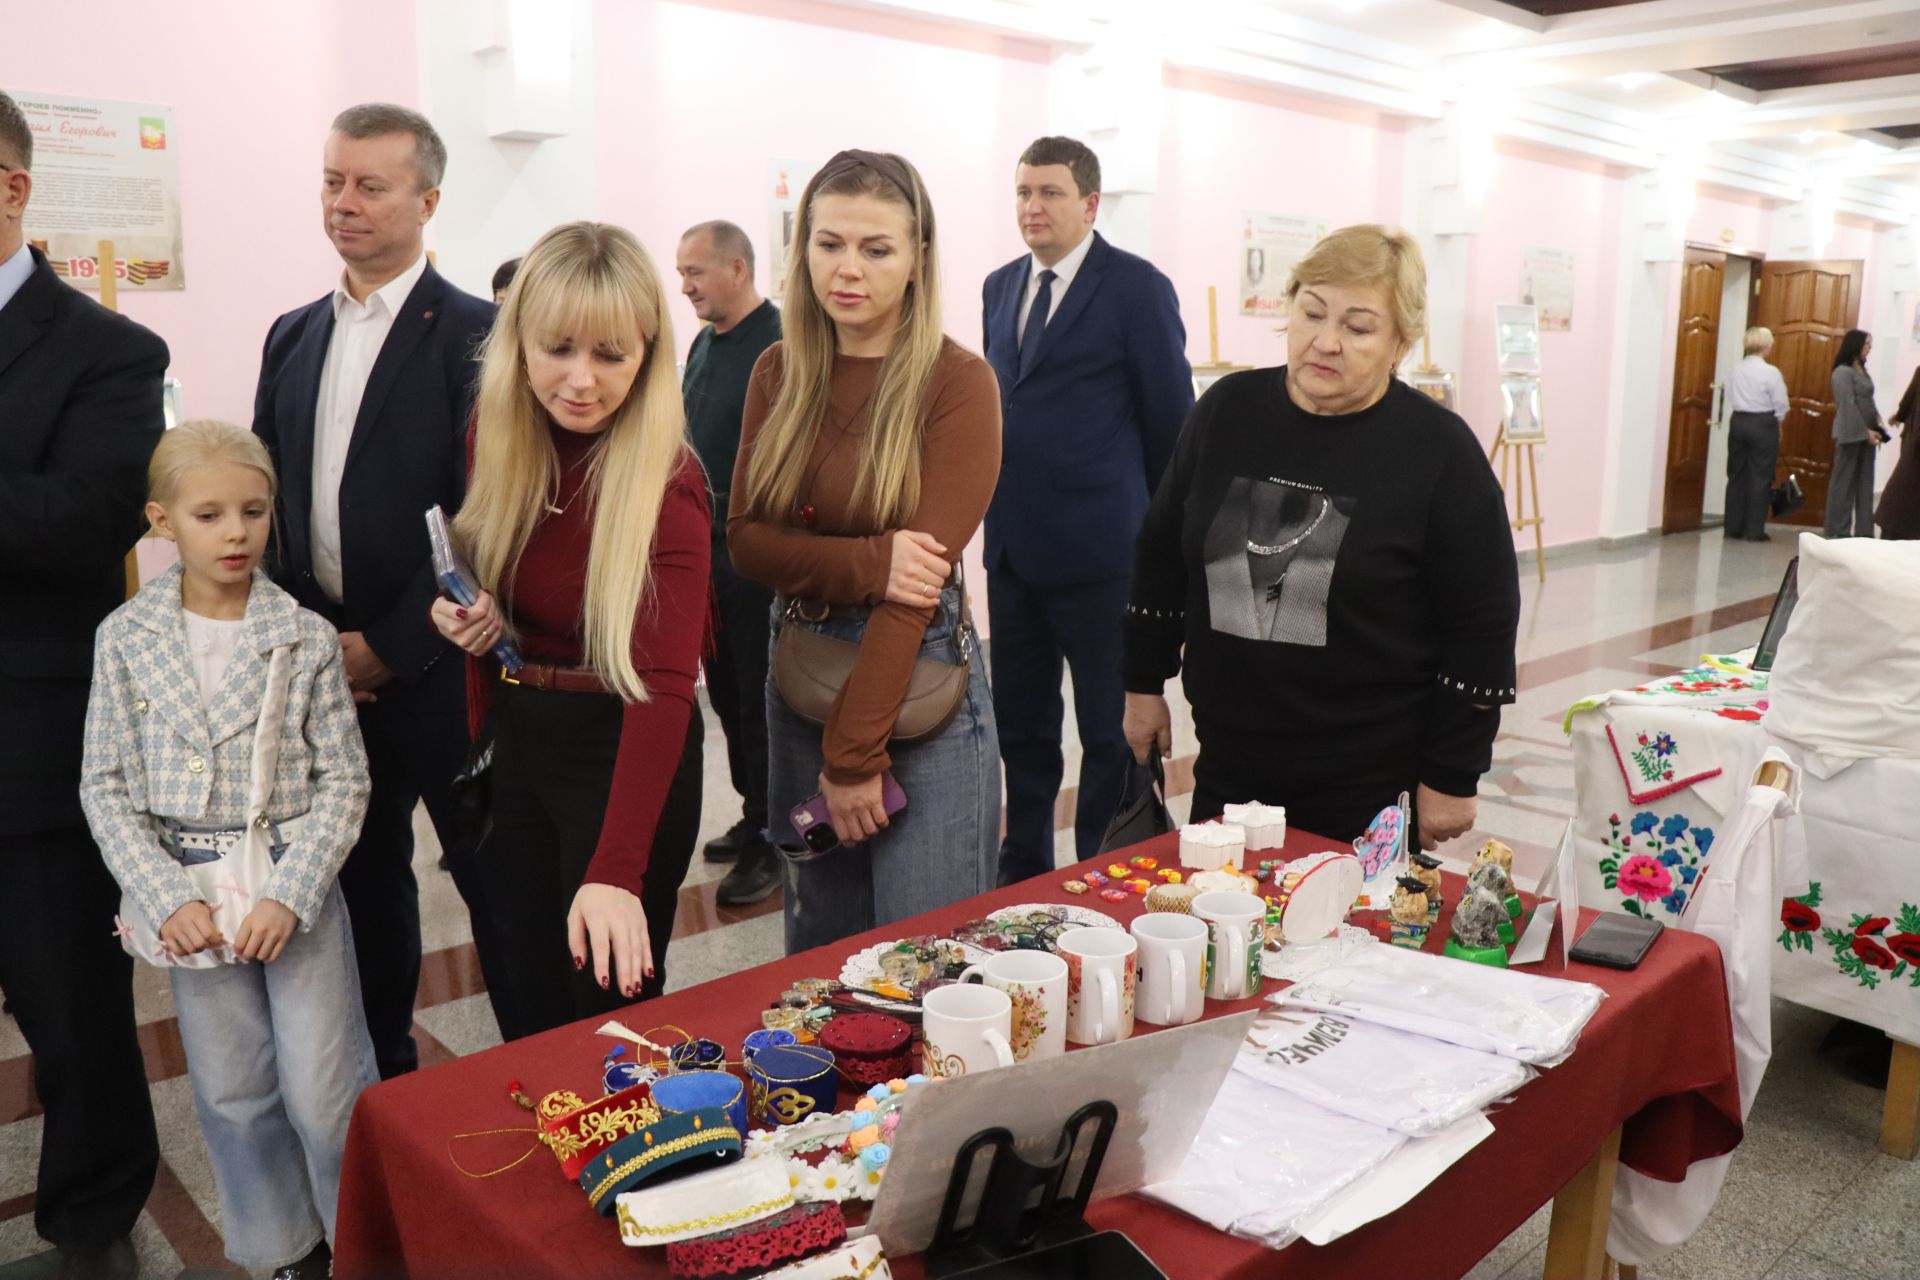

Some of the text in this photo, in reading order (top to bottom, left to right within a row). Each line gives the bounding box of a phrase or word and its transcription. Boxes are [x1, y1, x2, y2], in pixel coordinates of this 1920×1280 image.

[18, 101, 49, 110] ГЕРОЕВ
[59, 120, 117, 138] Егорович
[69, 258, 127, 279] 195
